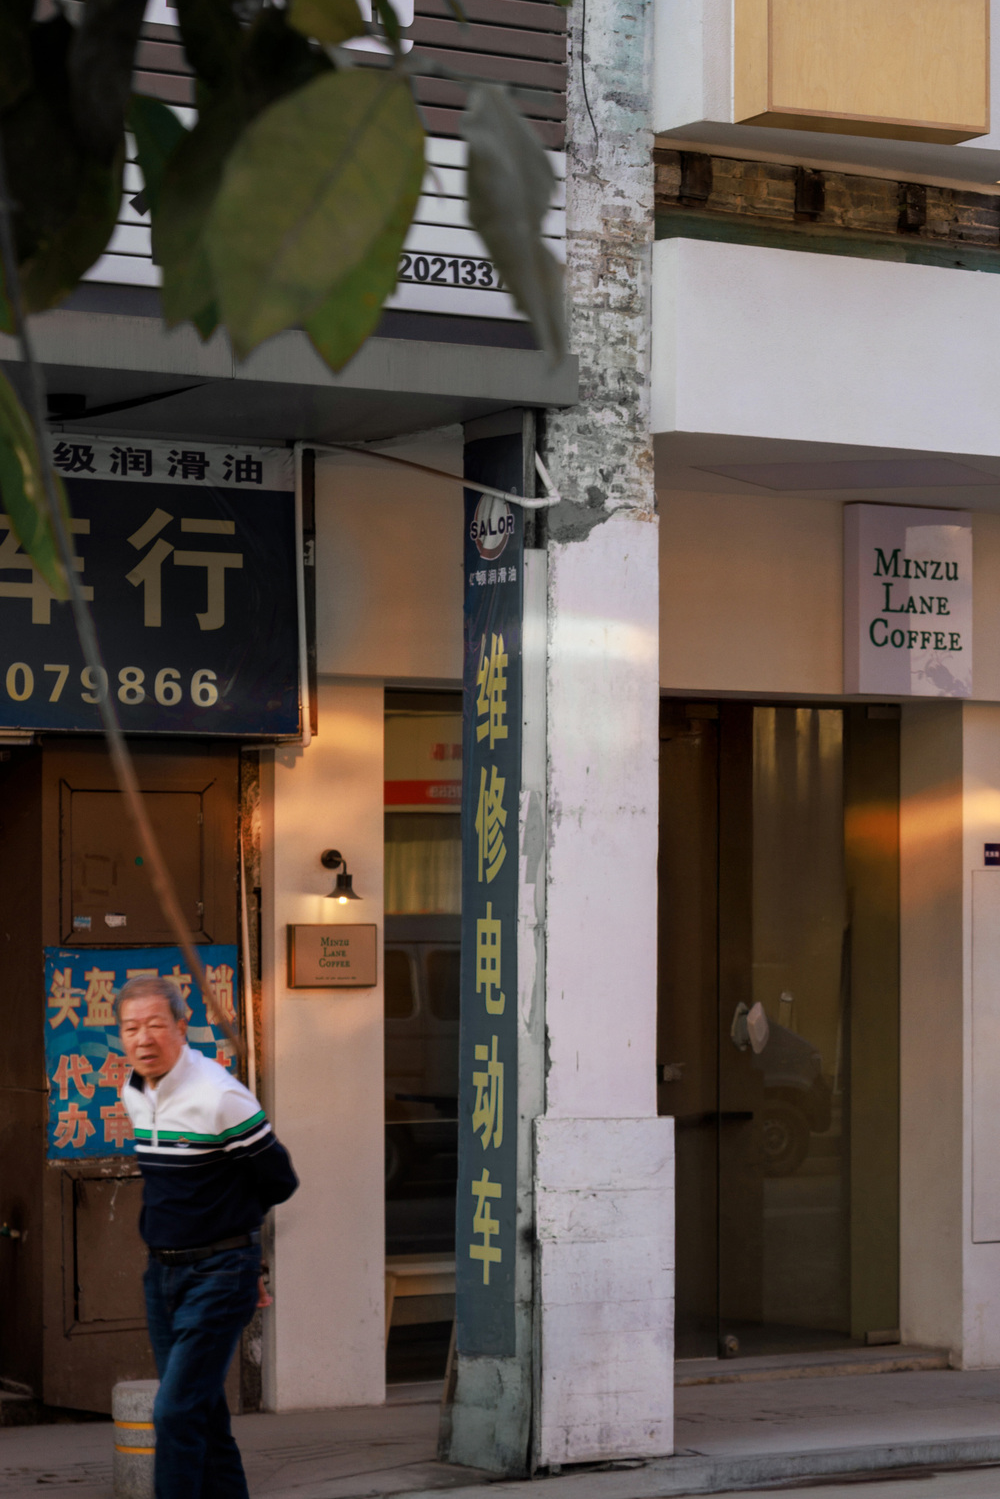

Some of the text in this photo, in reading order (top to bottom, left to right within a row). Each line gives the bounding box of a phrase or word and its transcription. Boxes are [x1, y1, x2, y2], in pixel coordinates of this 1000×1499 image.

[468, 632, 509, 1286] 维修电动车
